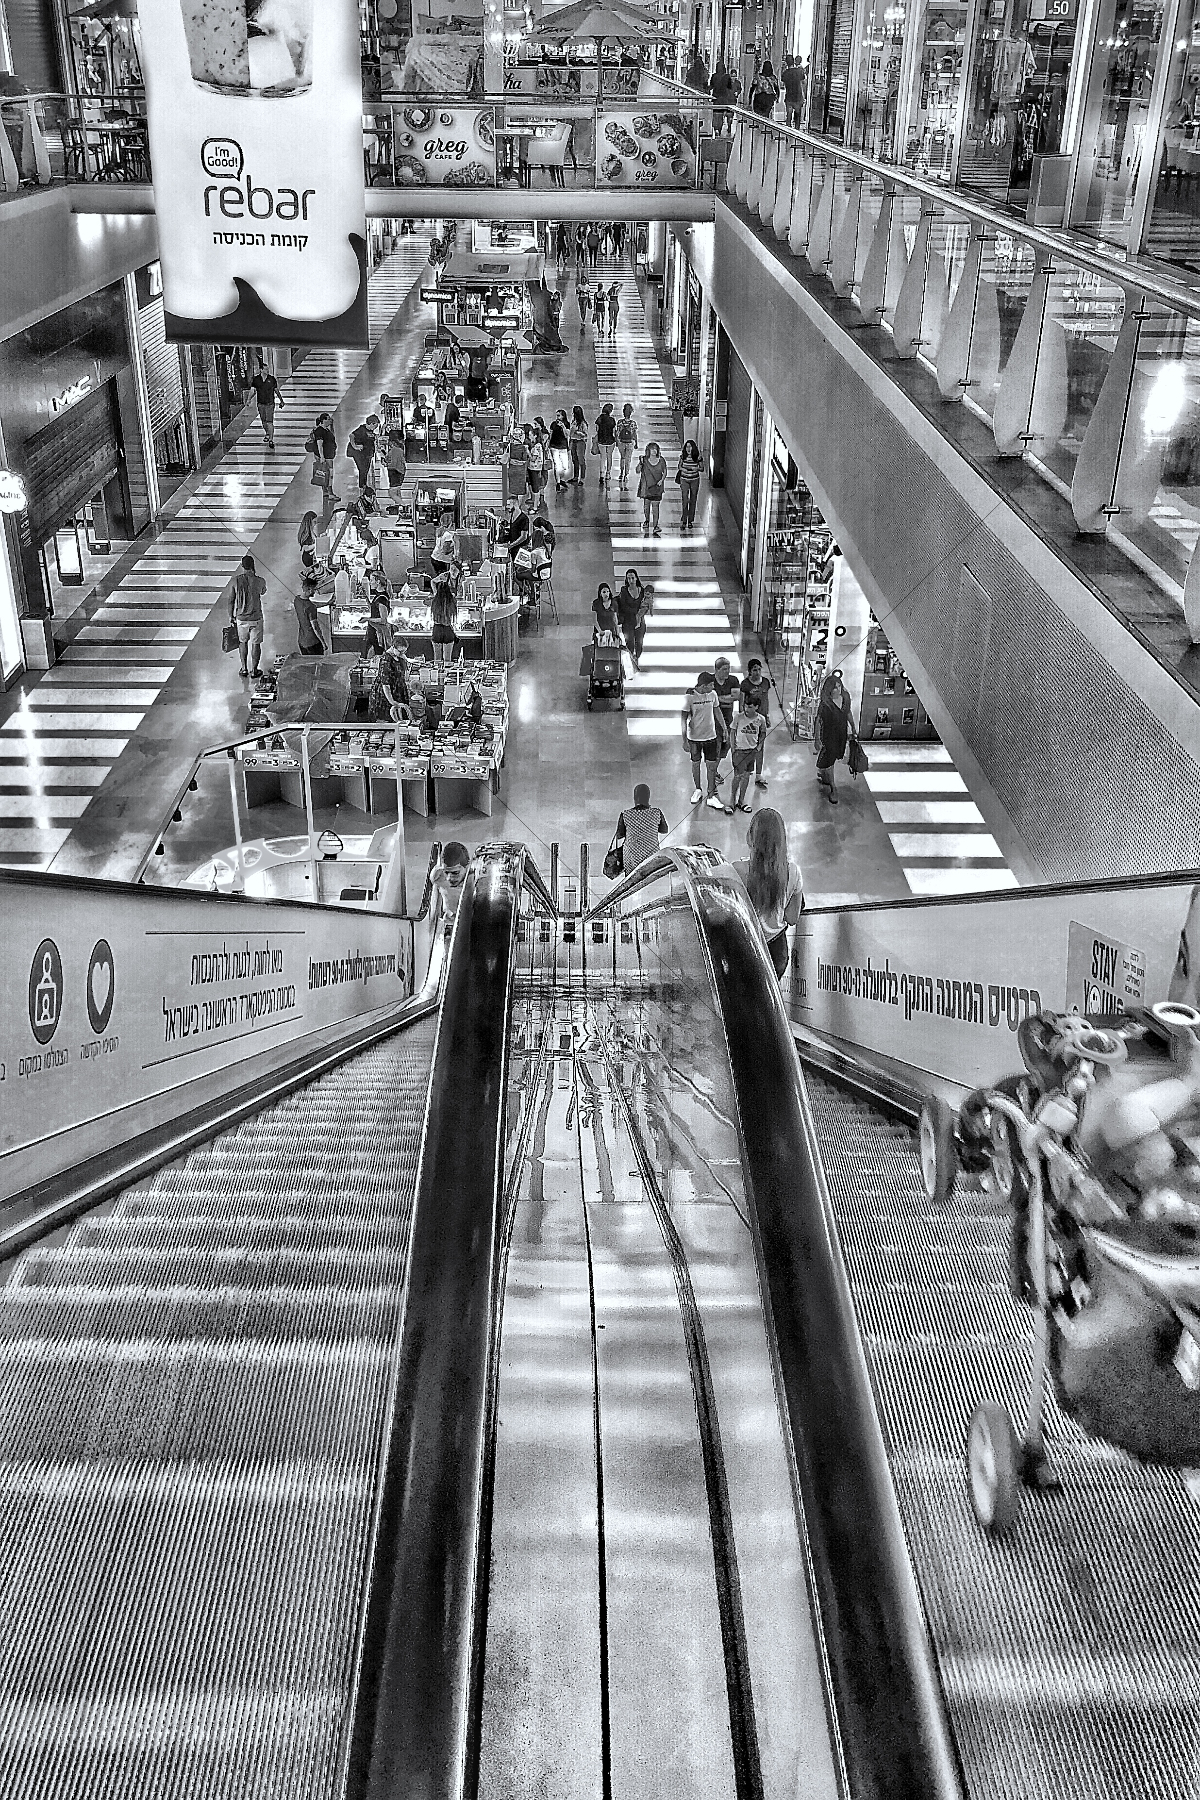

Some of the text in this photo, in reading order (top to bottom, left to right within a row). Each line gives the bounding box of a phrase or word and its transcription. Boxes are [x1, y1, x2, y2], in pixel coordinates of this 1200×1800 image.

[207, 156, 238, 168] Good!
[215, 146, 230, 158] I'm
[423, 138, 469, 160] greg
[635, 170, 659, 182] greg
[203, 174, 316, 221] rebar
[212, 231, 309, 252] קומת הכניסה
[244, 758, 258, 767] 99
[371, 764, 384, 773] 99
[433, 764, 446, 773] 99
[817, 956, 842, 992] רשתות!
[1091, 939, 1118, 988] STAY
[862, 957, 899, 1006] בלמעלה
[900, 972, 934, 1021] התקף
[936, 978, 984, 1025] המתנה
[162, 996, 199, 1043] בישראל
[201, 996, 238, 1033] הראשונה
[18, 1054, 42, 1080] במקום
